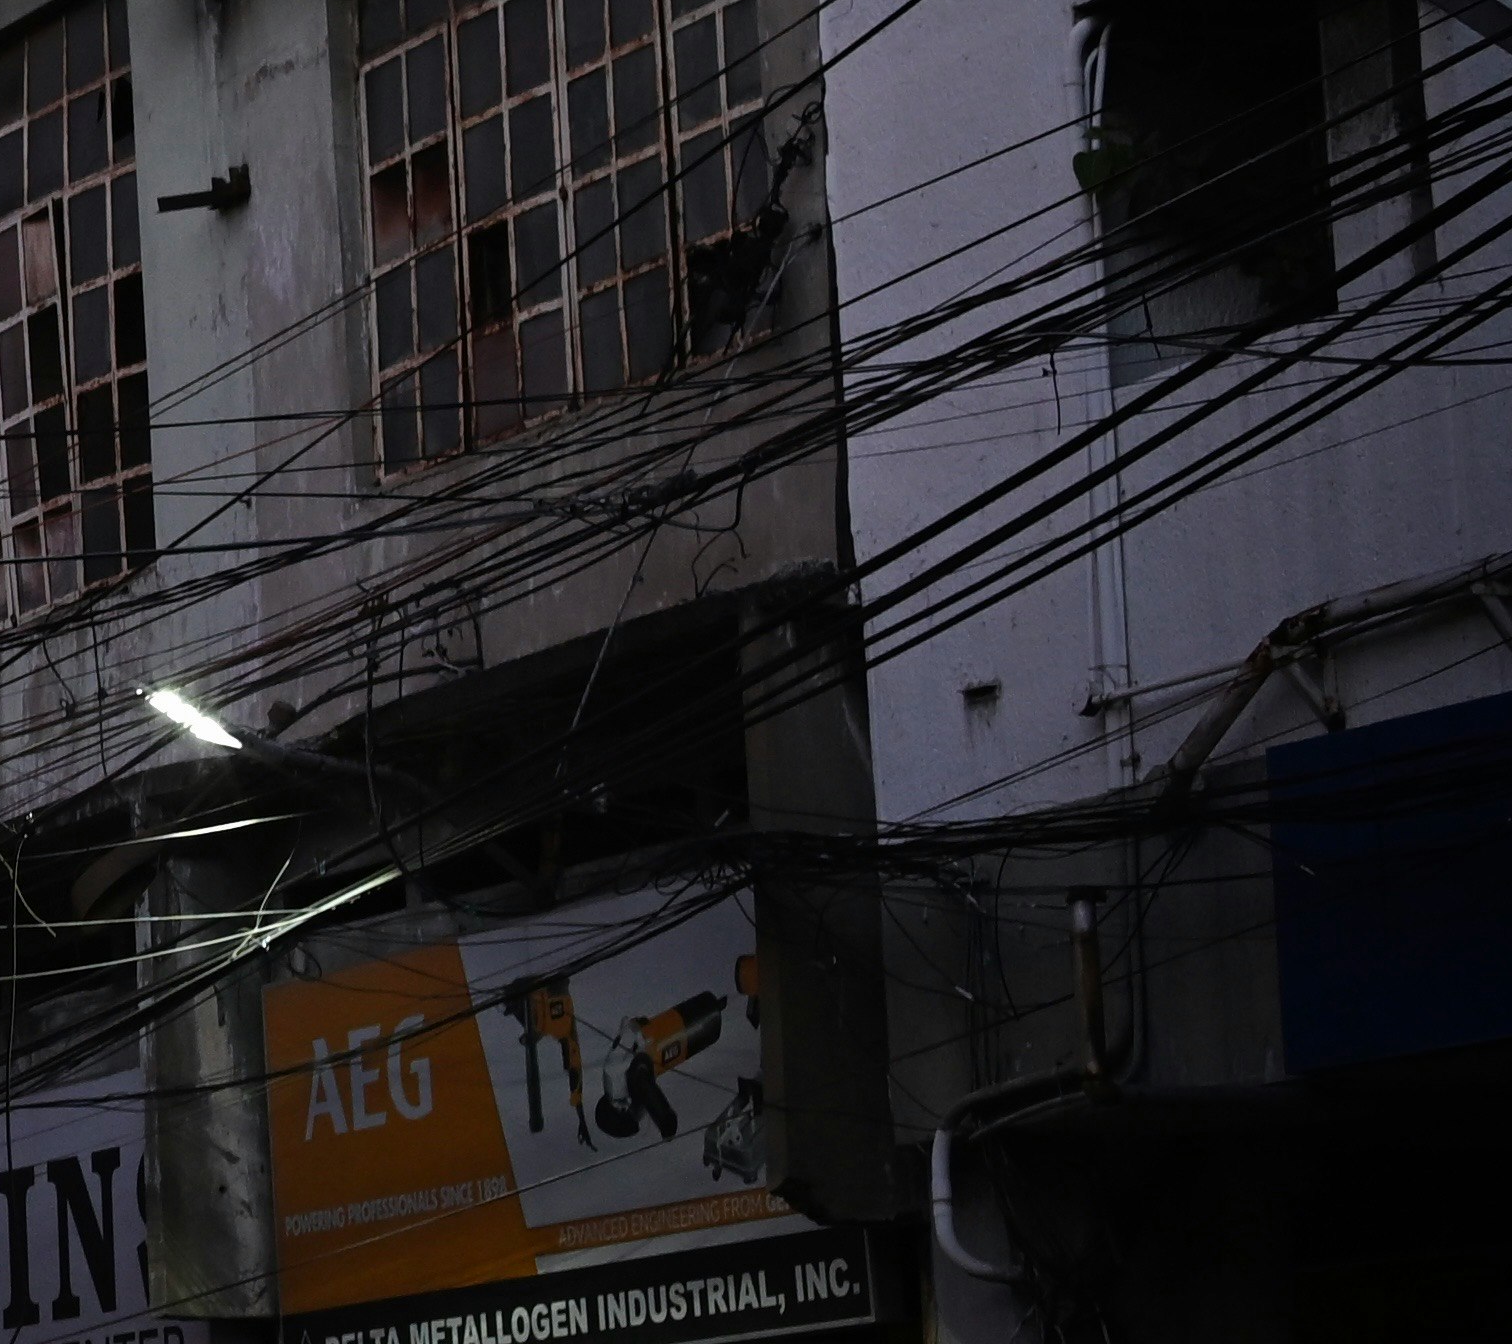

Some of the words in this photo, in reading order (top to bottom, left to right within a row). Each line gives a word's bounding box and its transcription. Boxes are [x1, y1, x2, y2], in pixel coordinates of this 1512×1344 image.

[305, 1014, 434, 1142] AEG
[284, 1207, 346, 1237] POWERING
[347, 1187, 439, 1226] PROFESSIONALS
[440, 1180, 474, 1208] SINCE
[557, 1217, 628, 1248] ADVANCED
[630, 1203, 721, 1237] ENGINEERING
[722, 1195, 765, 1220] FROM
[596, 1271, 785, 1332] INDUSTRIAL,
[793, 1258, 860, 1305] INC.
